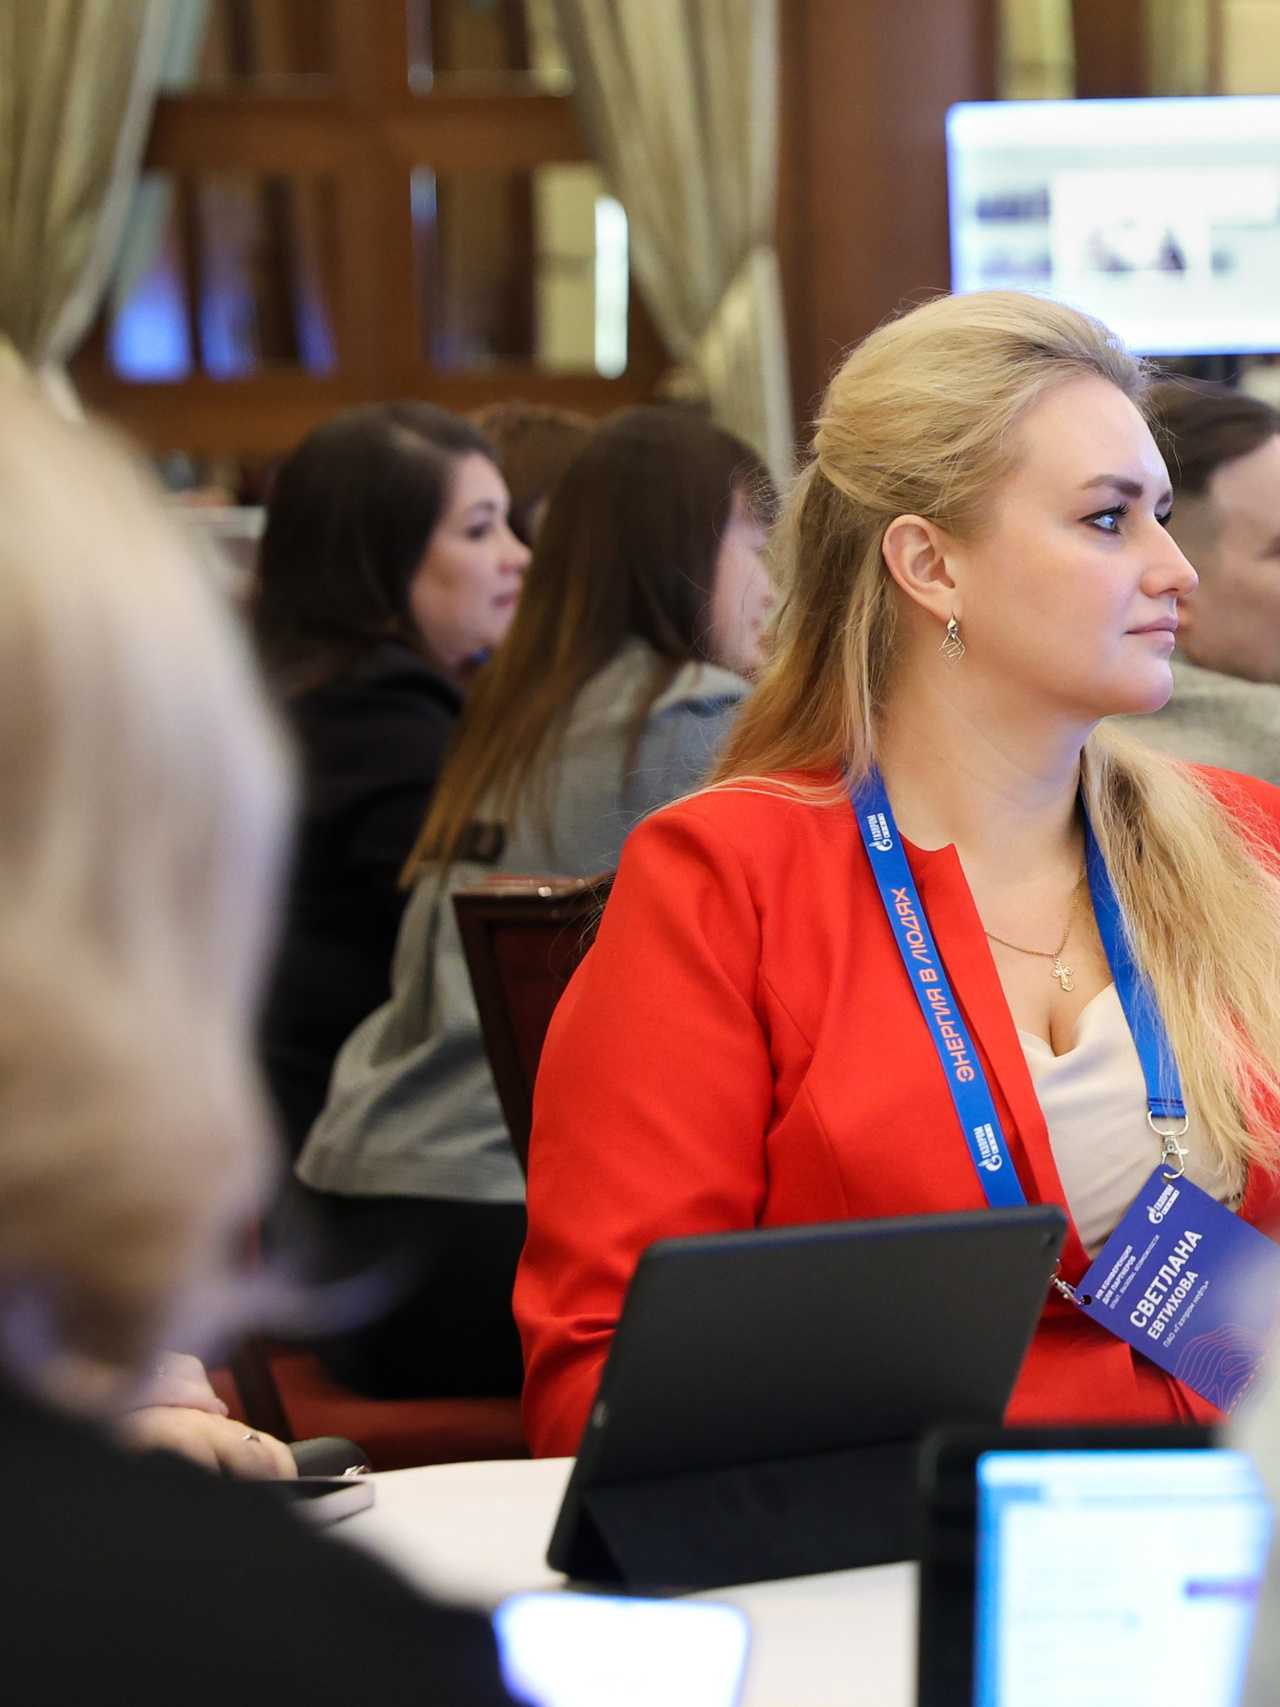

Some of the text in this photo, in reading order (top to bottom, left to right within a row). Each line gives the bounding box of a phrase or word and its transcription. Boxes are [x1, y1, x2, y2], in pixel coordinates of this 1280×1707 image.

[891, 887, 975, 1082] ЭНЕРГИЯ В ЛЮДЯХ
[1110, 1255, 1137, 1291] ПАРТНЕРОВ
[1130, 1230, 1203, 1328] СВЕТЛАНА
[1146, 1270, 1199, 1340] ЕВТИХОВА
[1163, 1332, 1176, 1348] ПАО
